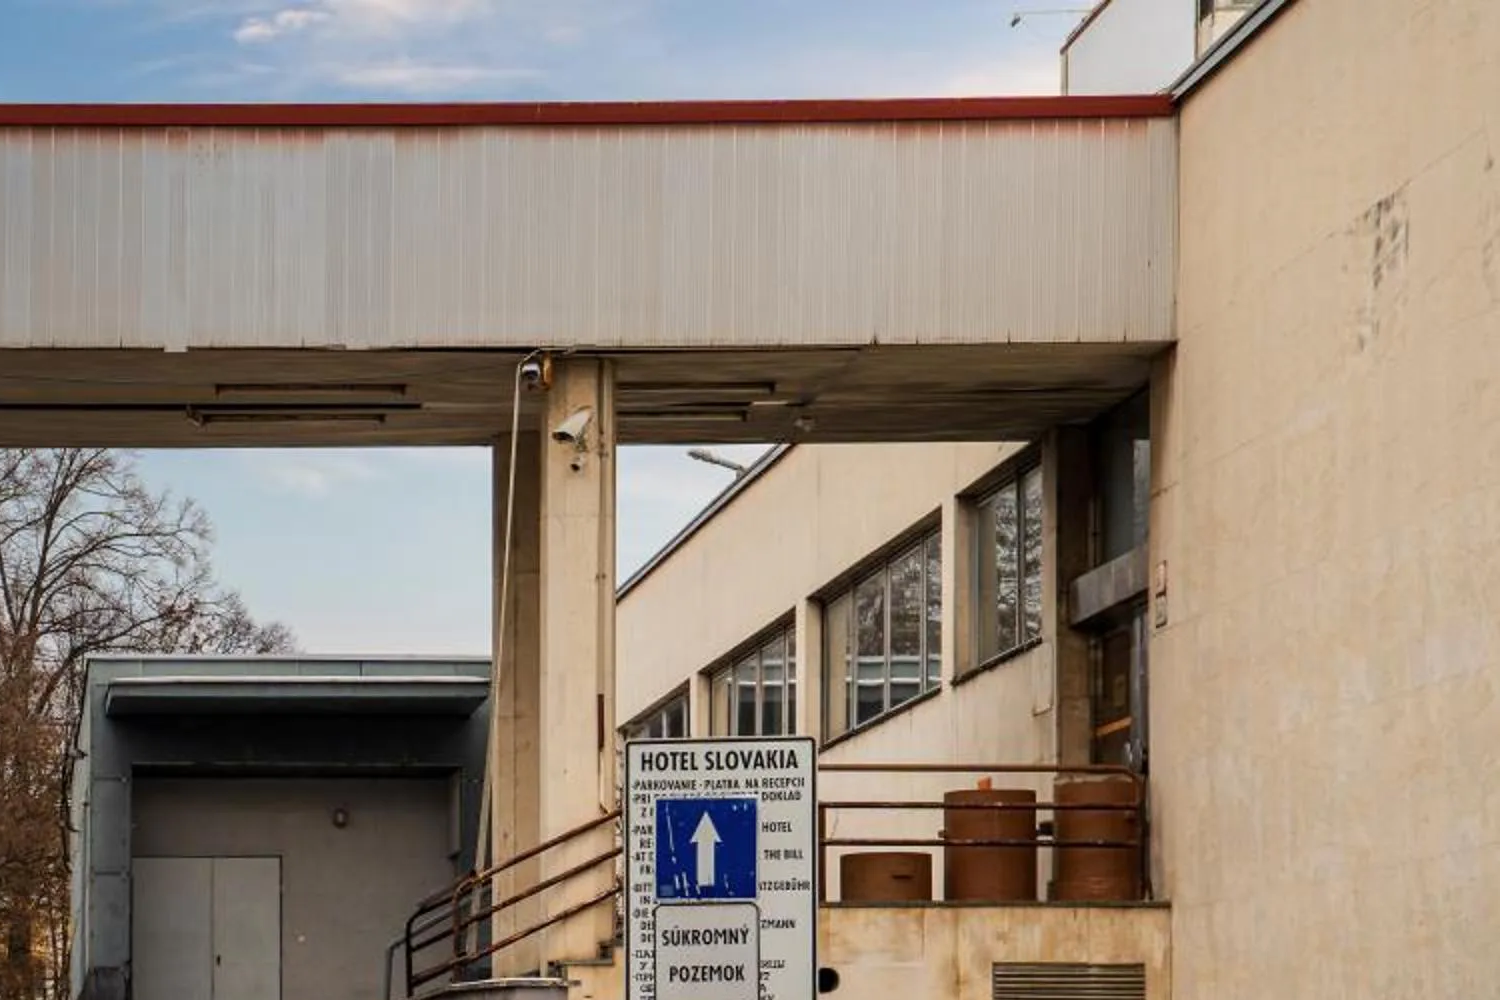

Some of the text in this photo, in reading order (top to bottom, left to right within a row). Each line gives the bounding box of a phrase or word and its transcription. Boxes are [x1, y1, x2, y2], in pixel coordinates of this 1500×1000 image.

[641, 749, 799, 772] HOTEL SLOVAKIA
[761, 821, 793, 833] HOTEL
[661, 924, 749, 946] SÚKROMNÝ
[669, 964, 745, 982] POZEMOK
